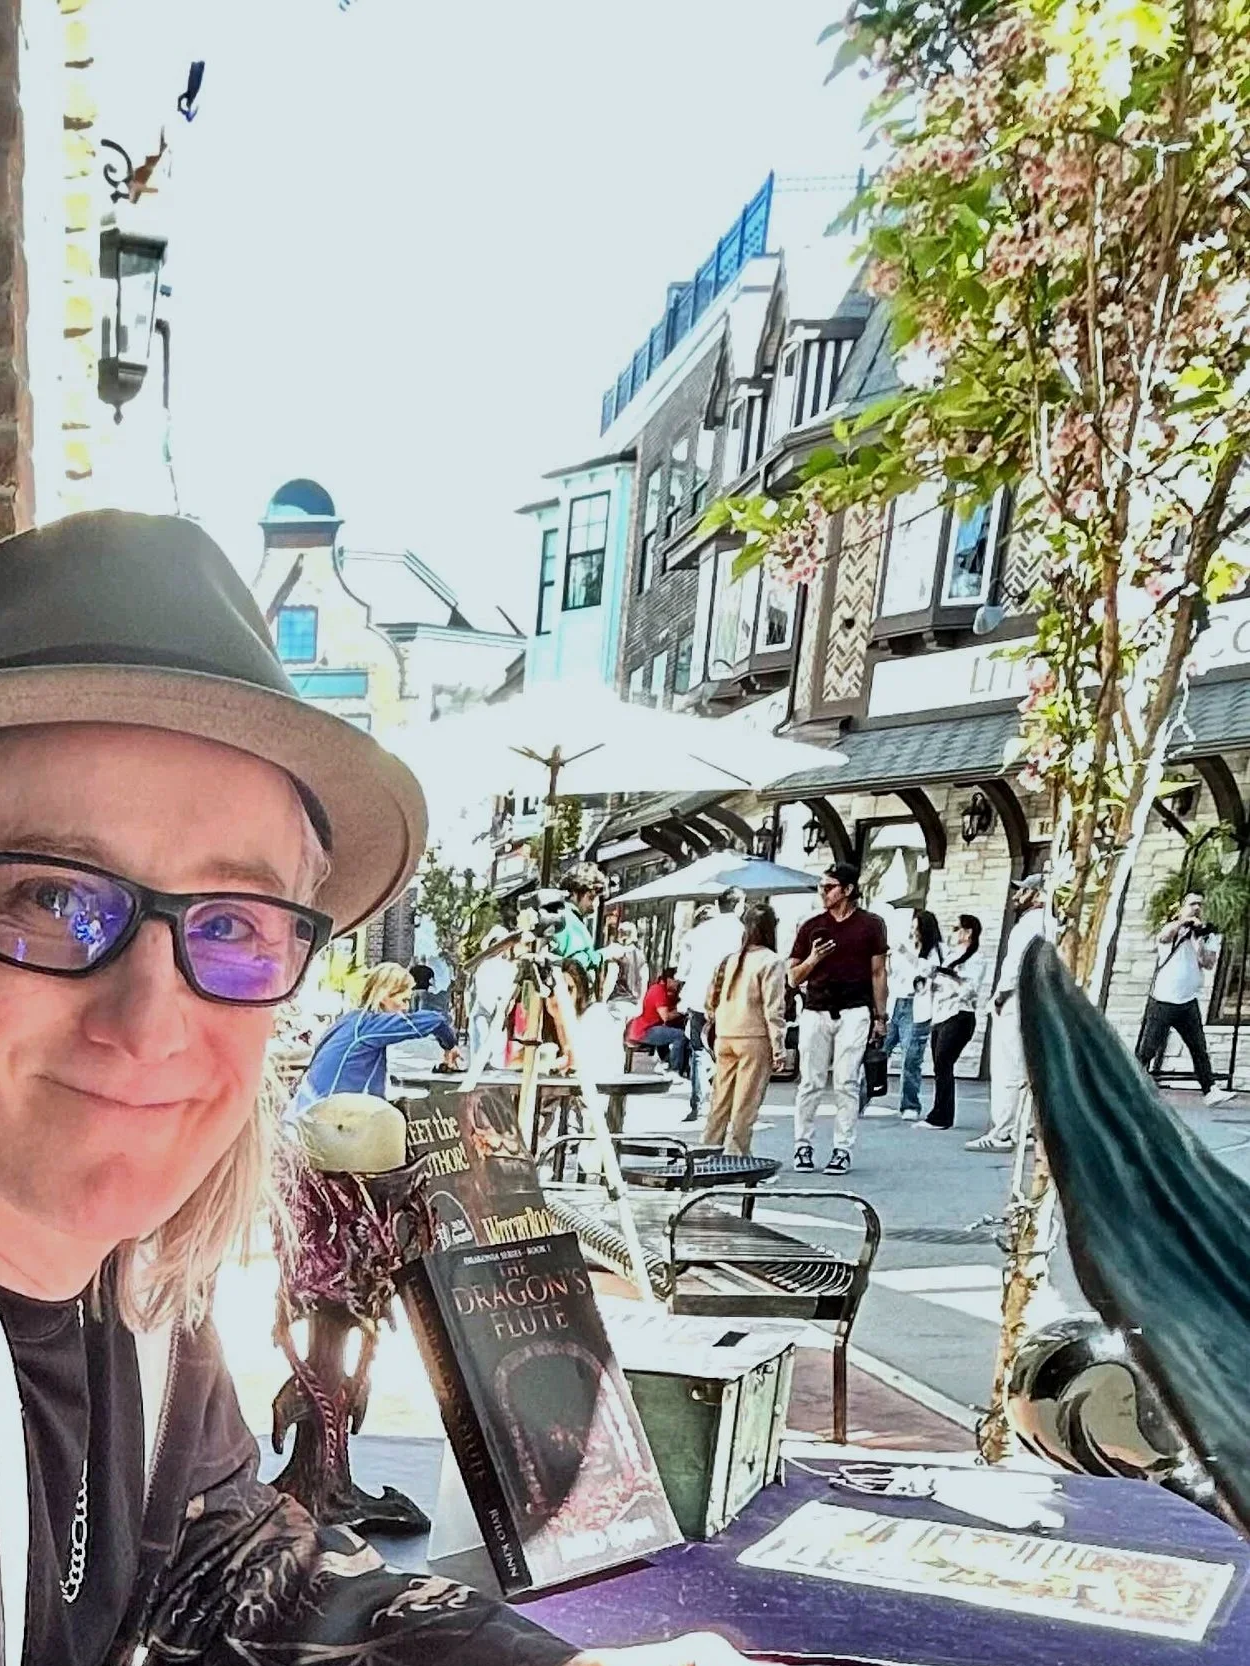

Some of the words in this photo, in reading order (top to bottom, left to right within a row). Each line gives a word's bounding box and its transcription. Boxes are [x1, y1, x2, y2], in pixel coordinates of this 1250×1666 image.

[408, 1117, 435, 1146] EET
[433, 1107, 461, 1141] the
[450, 1267, 588, 1315] DRAGON'S
[489, 1301, 570, 1340] FLUTE
[500, 1538, 520, 1579] KINN
